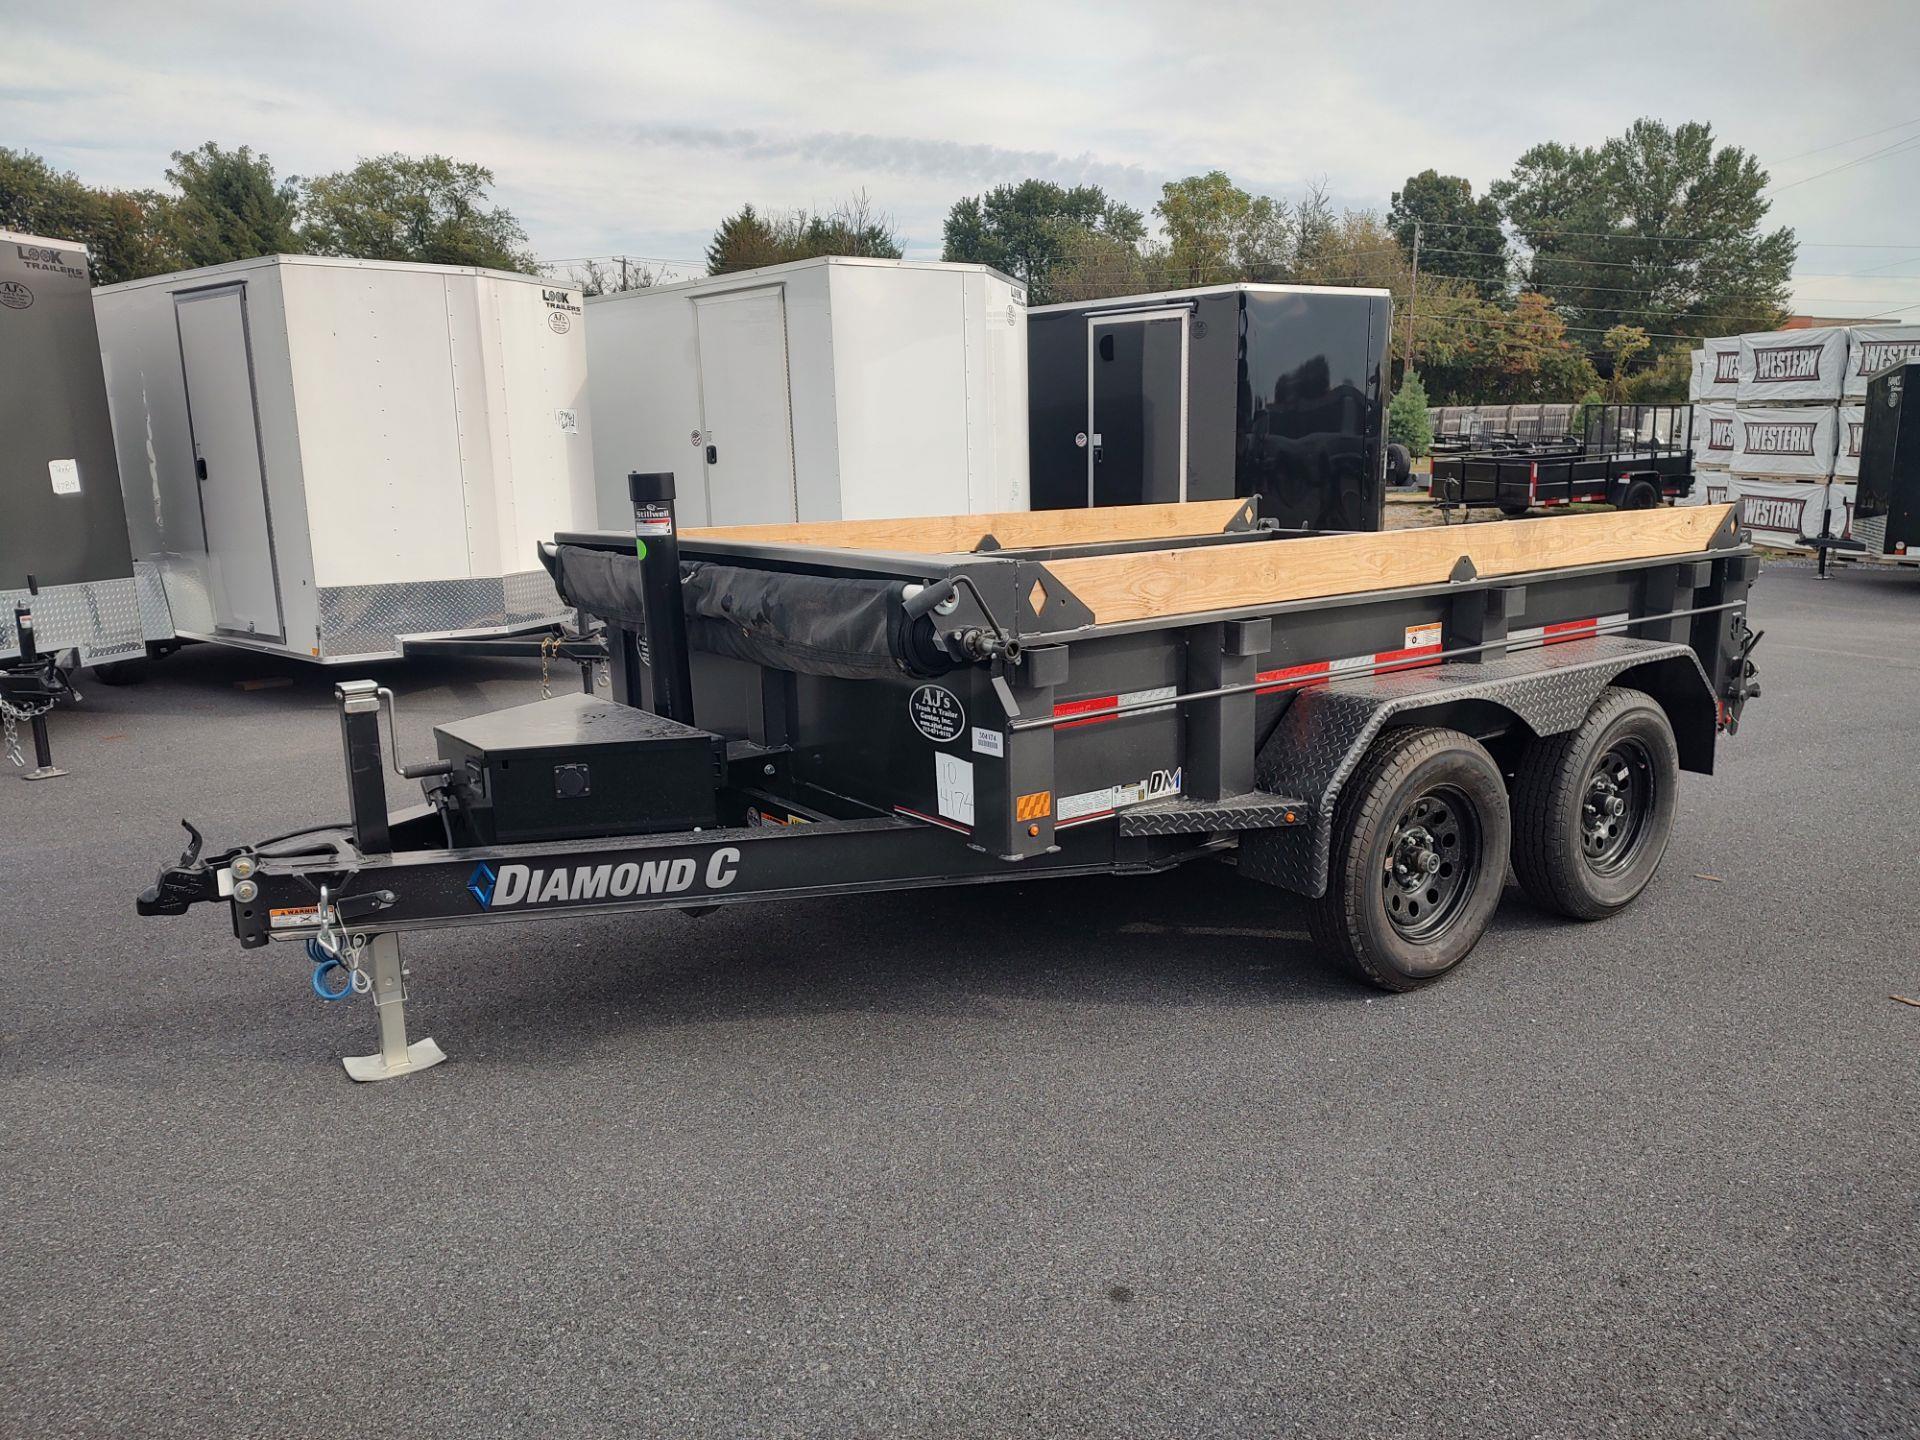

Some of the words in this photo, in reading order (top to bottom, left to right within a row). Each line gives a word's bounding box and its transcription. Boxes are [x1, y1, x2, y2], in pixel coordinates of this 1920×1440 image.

[17, 245, 63, 265] LOOK
[24, 261, 84, 275] TRAILERS
[542, 289, 569, 304] LOOK
[546, 302, 581, 312] TRAILERS
[1757, 350, 1818, 379] WESTERN
[1749, 426, 1811, 452] WESTERN
[1744, 499, 1800, 529] WESTERN
[922, 687, 950, 709] AJ's
[491, 858, 697, 906] DIAMOND
[705, 847, 740, 890] C
